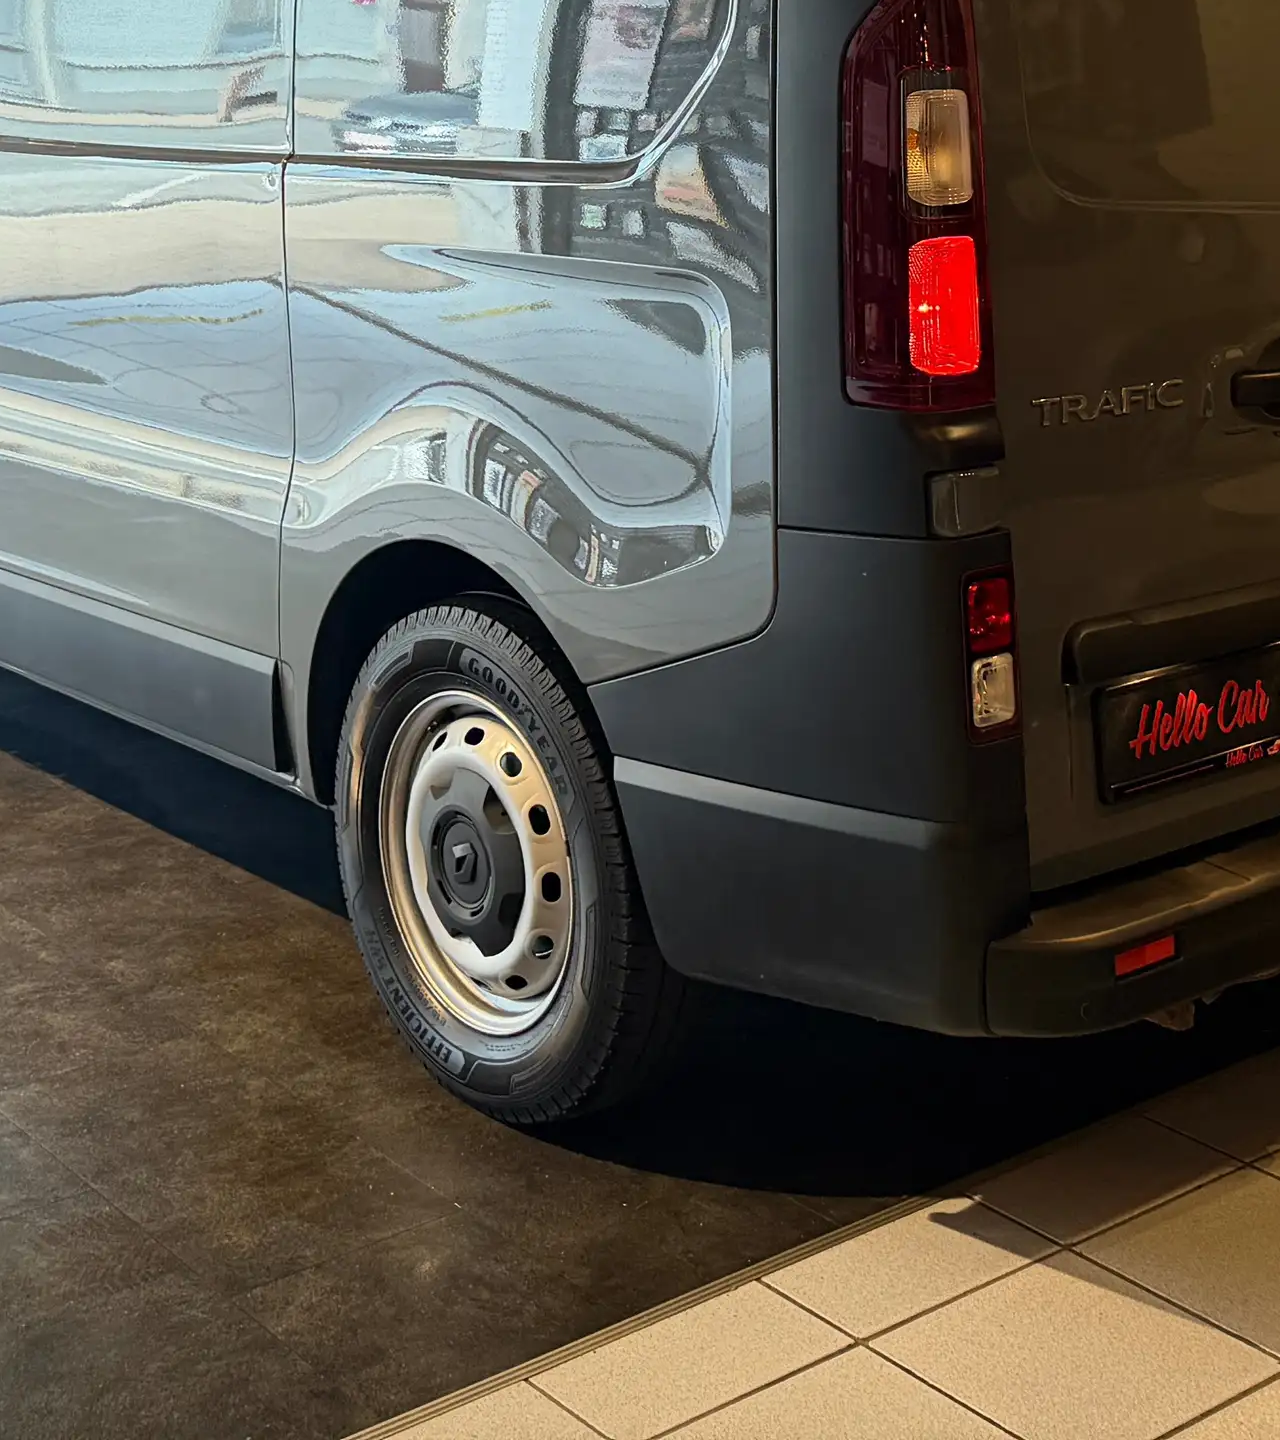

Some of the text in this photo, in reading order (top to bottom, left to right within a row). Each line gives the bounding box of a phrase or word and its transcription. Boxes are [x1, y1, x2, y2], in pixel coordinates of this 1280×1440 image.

[1031, 378, 1184, 427] TRAFIC
[468, 658, 568, 795] GOODYEAR
[1129, 680, 1270, 758] Hello Car
[1225, 751, 1247, 768] Hello
[383, 977, 453, 1063] EFFICIENT
